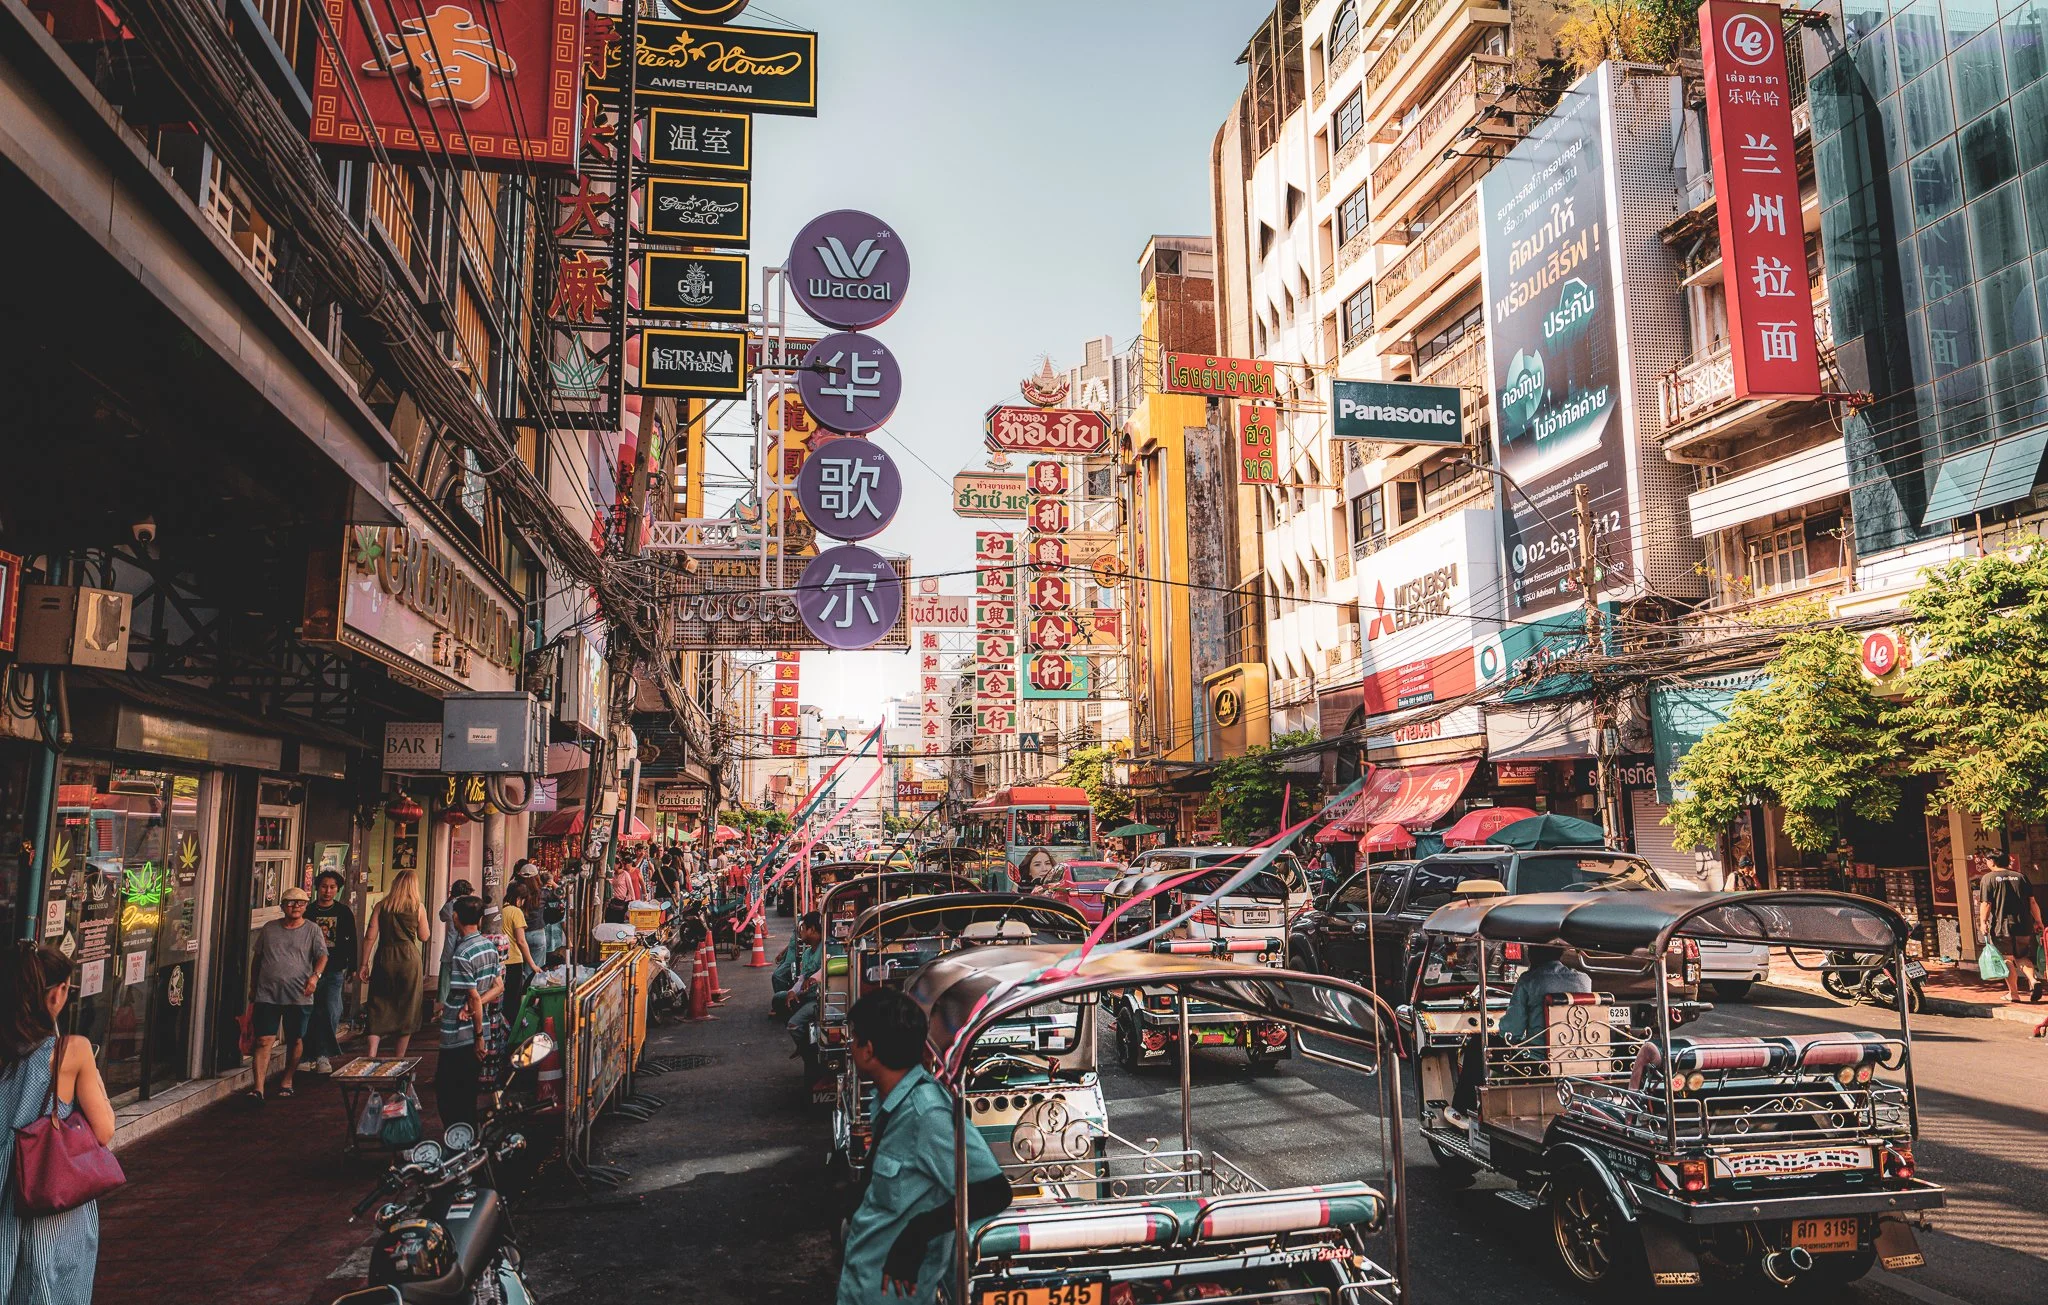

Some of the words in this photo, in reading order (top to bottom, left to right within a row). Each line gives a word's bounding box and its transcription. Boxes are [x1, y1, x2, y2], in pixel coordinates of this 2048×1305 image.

[649, 77, 753, 94] AMSTERDAM
[1728, 88, 1780, 107] 乐哈哈
[669, 123, 731, 155] 温室
[1509, 195, 1575, 276] คัดมาให้
[1740, 133, 1798, 362] 兰州拉面
[1495, 228, 1588, 322] พร้อมเสิร์ฟ
[809, 278, 891, 300] Wacoal
[1543, 289, 1595, 339] ประกัน
[659, 348, 723, 364] STRAIN
[660, 361, 723, 373] HUNTERS
[1167, 355, 1273, 395] โรงรับจำนำ
[1502, 371, 1541, 410] กองทุน
[1339, 399, 1456, 426] Panasonic
[1533, 388, 1607, 441] ไม่จำกัดค่าย
[999, 413, 1100, 448] ทองใบ
[1245, 449, 1272, 480] หลี
[958, 484, 1030, 509] ฮั่วเซ่งเฮ
[1394, 562, 1458, 603] MITSUBISHI
[1395, 592, 1451, 632] ELECTRIC
[387, 737, 426, 753] BAR
[899, 784, 912, 795] 24
[121, 905, 160, 931] Open
[1609, 1008, 1629, 1018] 6293
[1618, 1152, 1637, 1166] 3195
[1728, 1149, 1859, 1174] THAILAND
[1824, 1219, 1857, 1238] 3195
[1049, 1285, 1091, 1305] 545
